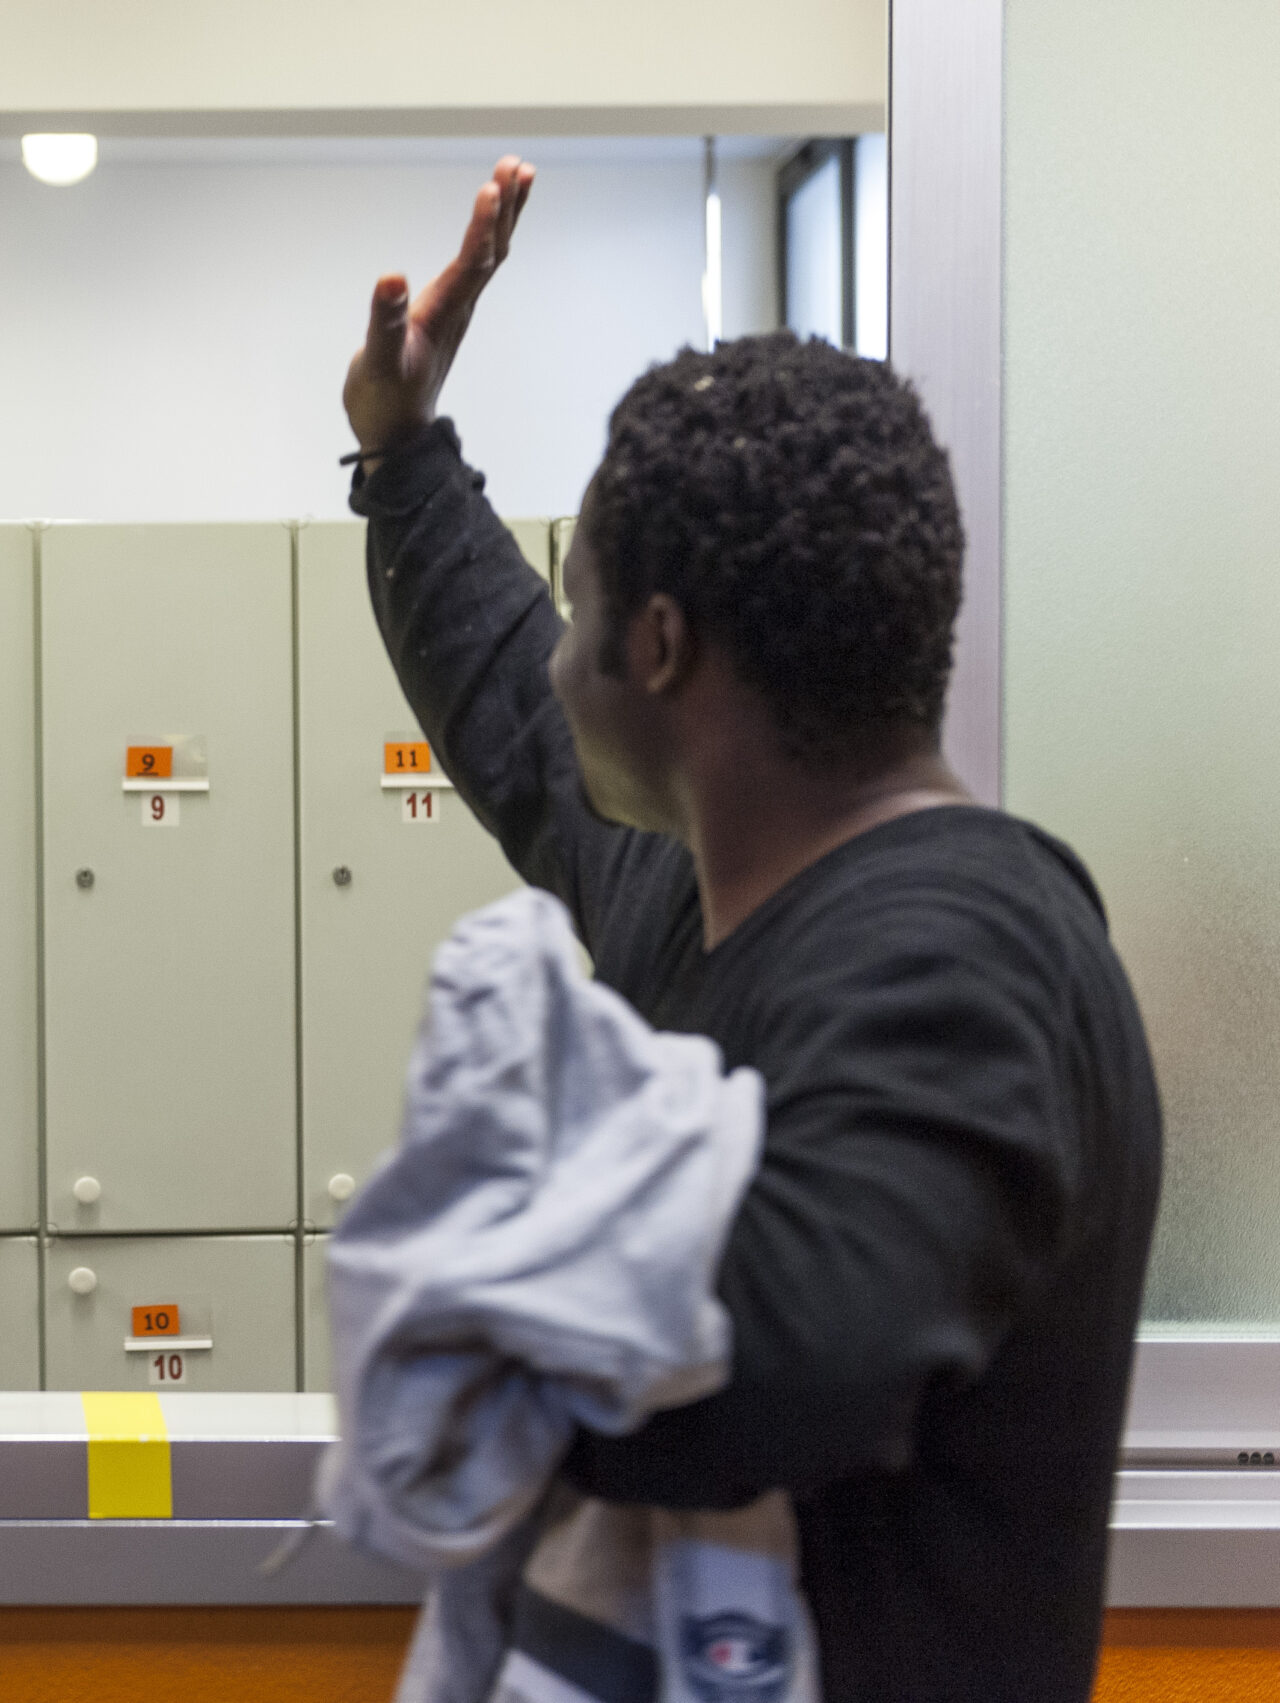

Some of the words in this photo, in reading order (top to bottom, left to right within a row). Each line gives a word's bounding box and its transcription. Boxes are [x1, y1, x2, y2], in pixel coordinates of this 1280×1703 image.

[142, 754, 155, 772] 9
[396, 750, 417, 767] 11
[151, 795, 165, 821] 9
[406, 792, 432, 818] 11
[144, 1312, 169, 1331] 10
[154, 1354, 182, 1380] 10
